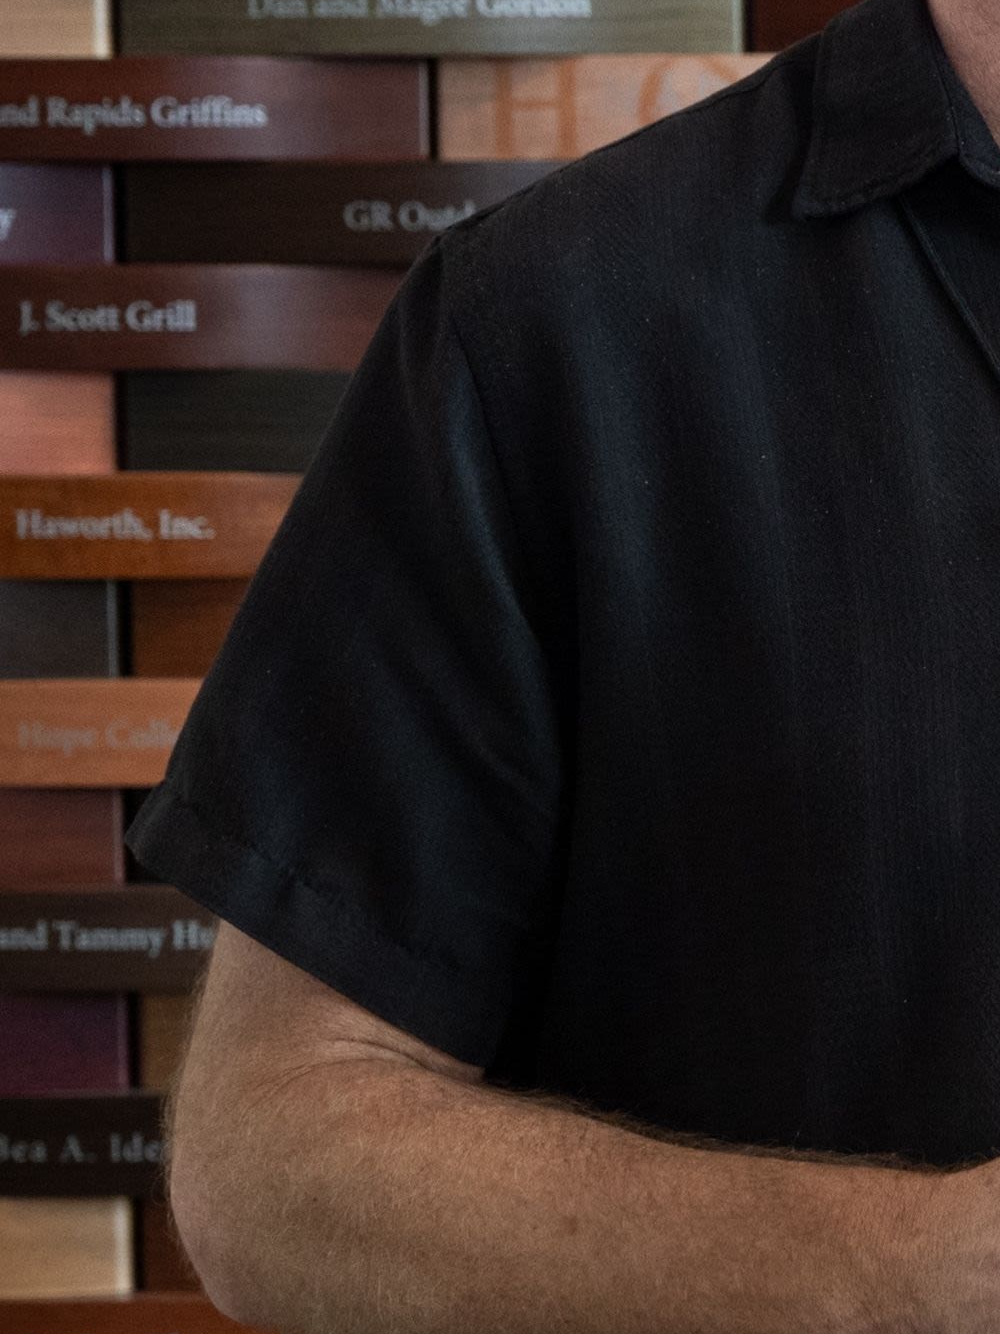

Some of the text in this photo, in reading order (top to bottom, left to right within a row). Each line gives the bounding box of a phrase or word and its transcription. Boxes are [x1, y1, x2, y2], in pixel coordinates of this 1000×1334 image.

[47, 95, 146, 136] Rapids
[151, 94, 269, 128] Griffins
[342, 199, 393, 232] GR
[45, 300, 119, 333] Scott
[126, 299, 196, 332] Grill
[15, 509, 216, 541] Haworth, Inc.
[53, 920, 165, 958] Tammy
